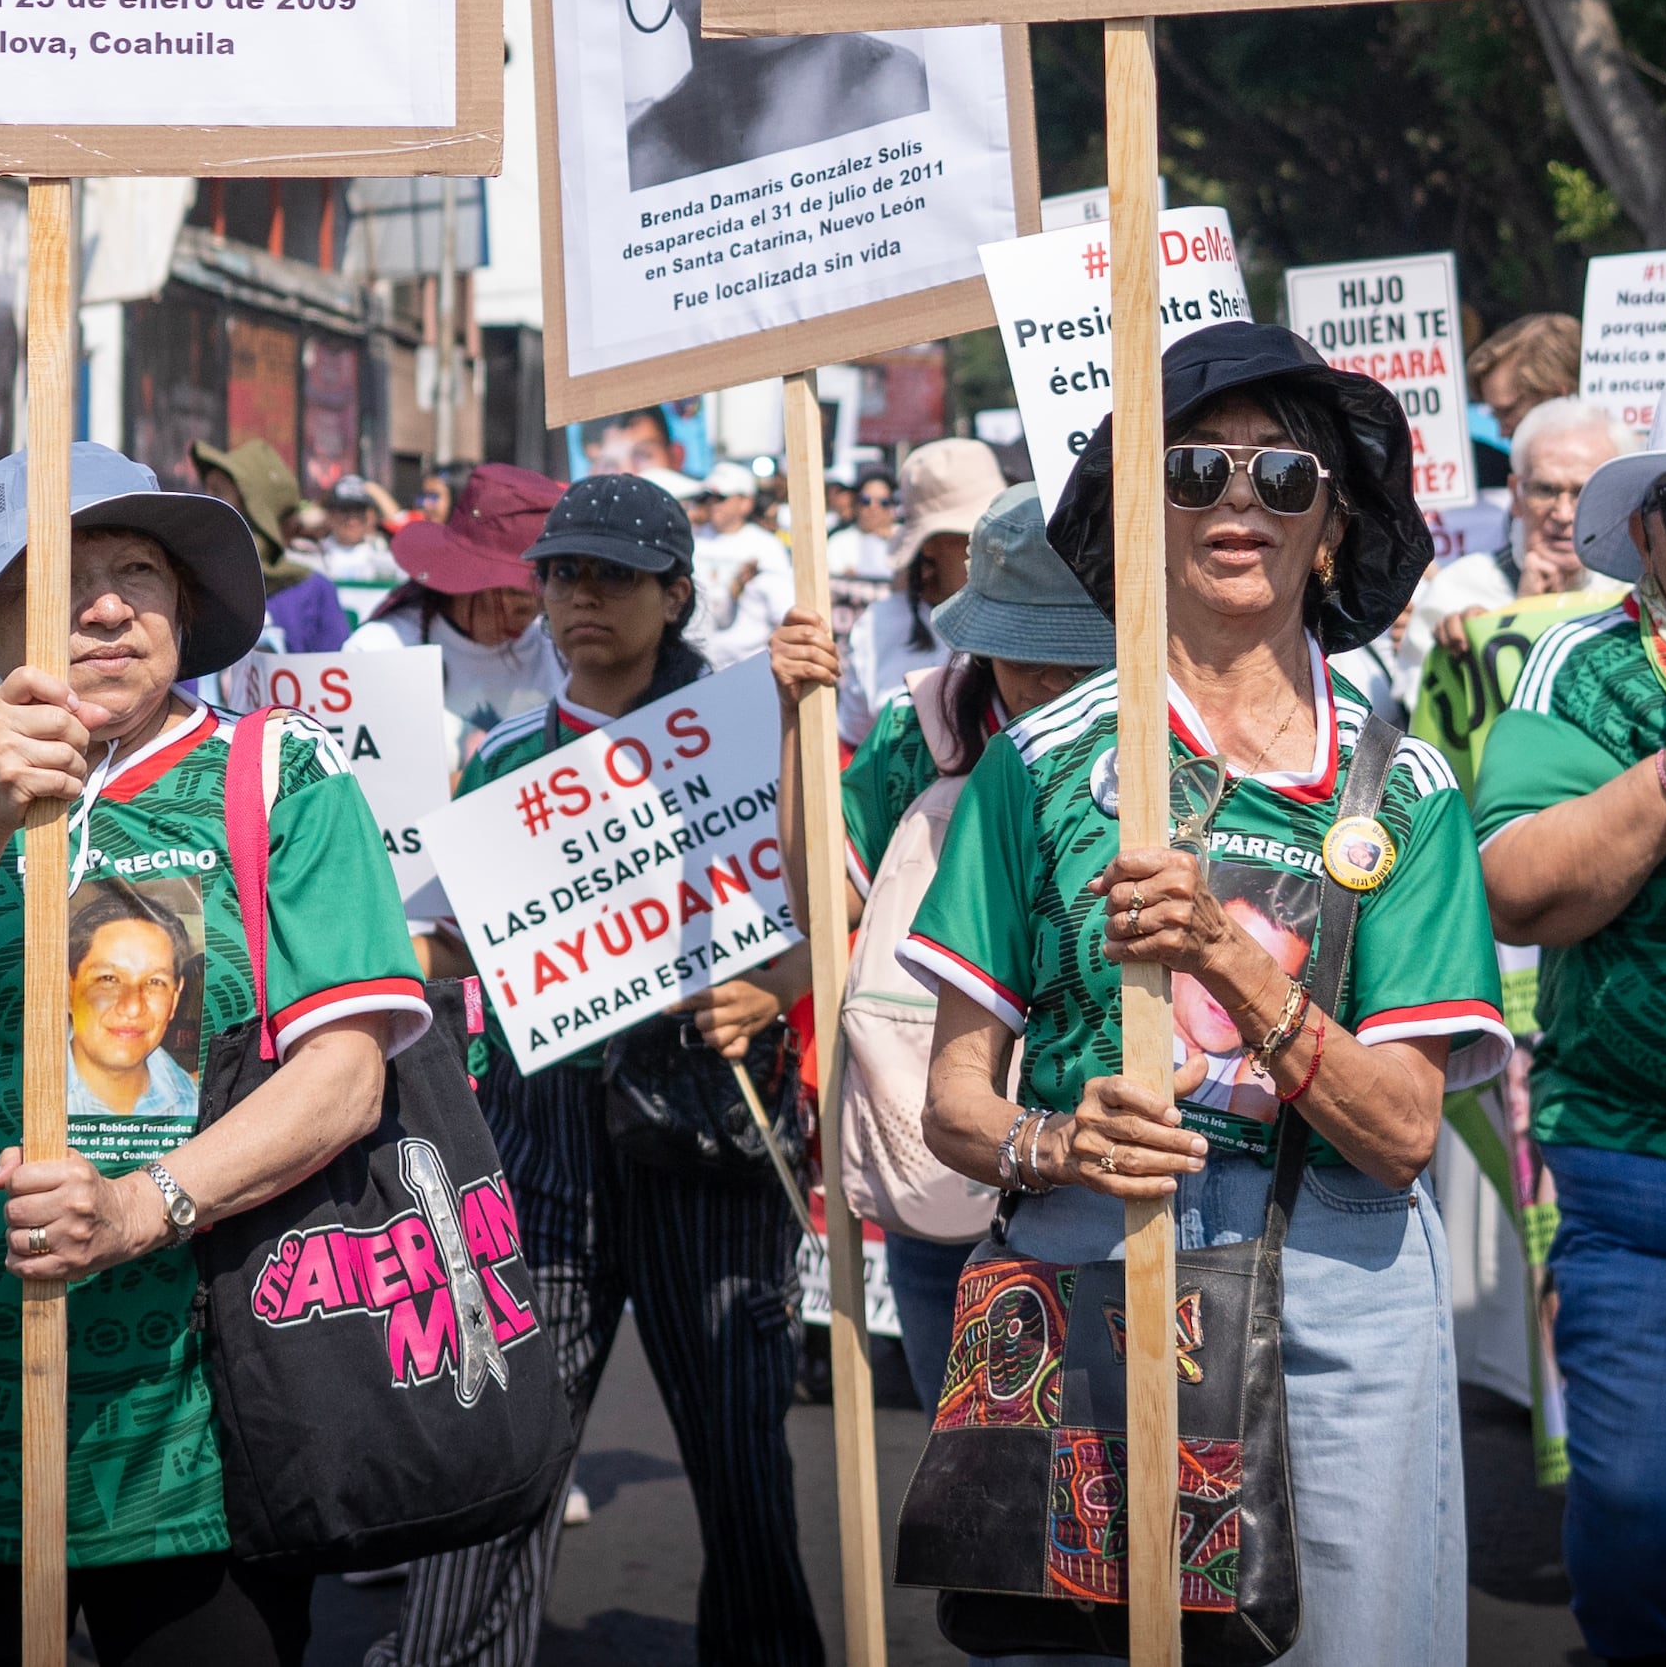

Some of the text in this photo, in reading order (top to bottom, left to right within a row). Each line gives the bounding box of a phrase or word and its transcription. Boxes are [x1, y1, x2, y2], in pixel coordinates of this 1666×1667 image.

[89, 31, 234, 55] Coahuila
[622, 160, 943, 260] desaparecida el 31 de julio de 2011
[641, 141, 923, 229] Brenda Damaris González Solís
[645, 196, 926, 281] en Santa Catarina, Nuevo León
[673, 239, 901, 311] Fue localizada sin vida
[1338, 275, 1405, 310] HIJO
[1616, 289, 1666, 307] Nada
[1415, 309, 1448, 339] TE
[515, 707, 711, 838] #S.O.S
[482, 899, 547, 947] LAS
[530, 940, 731, 1052] A PARAR ESTA
